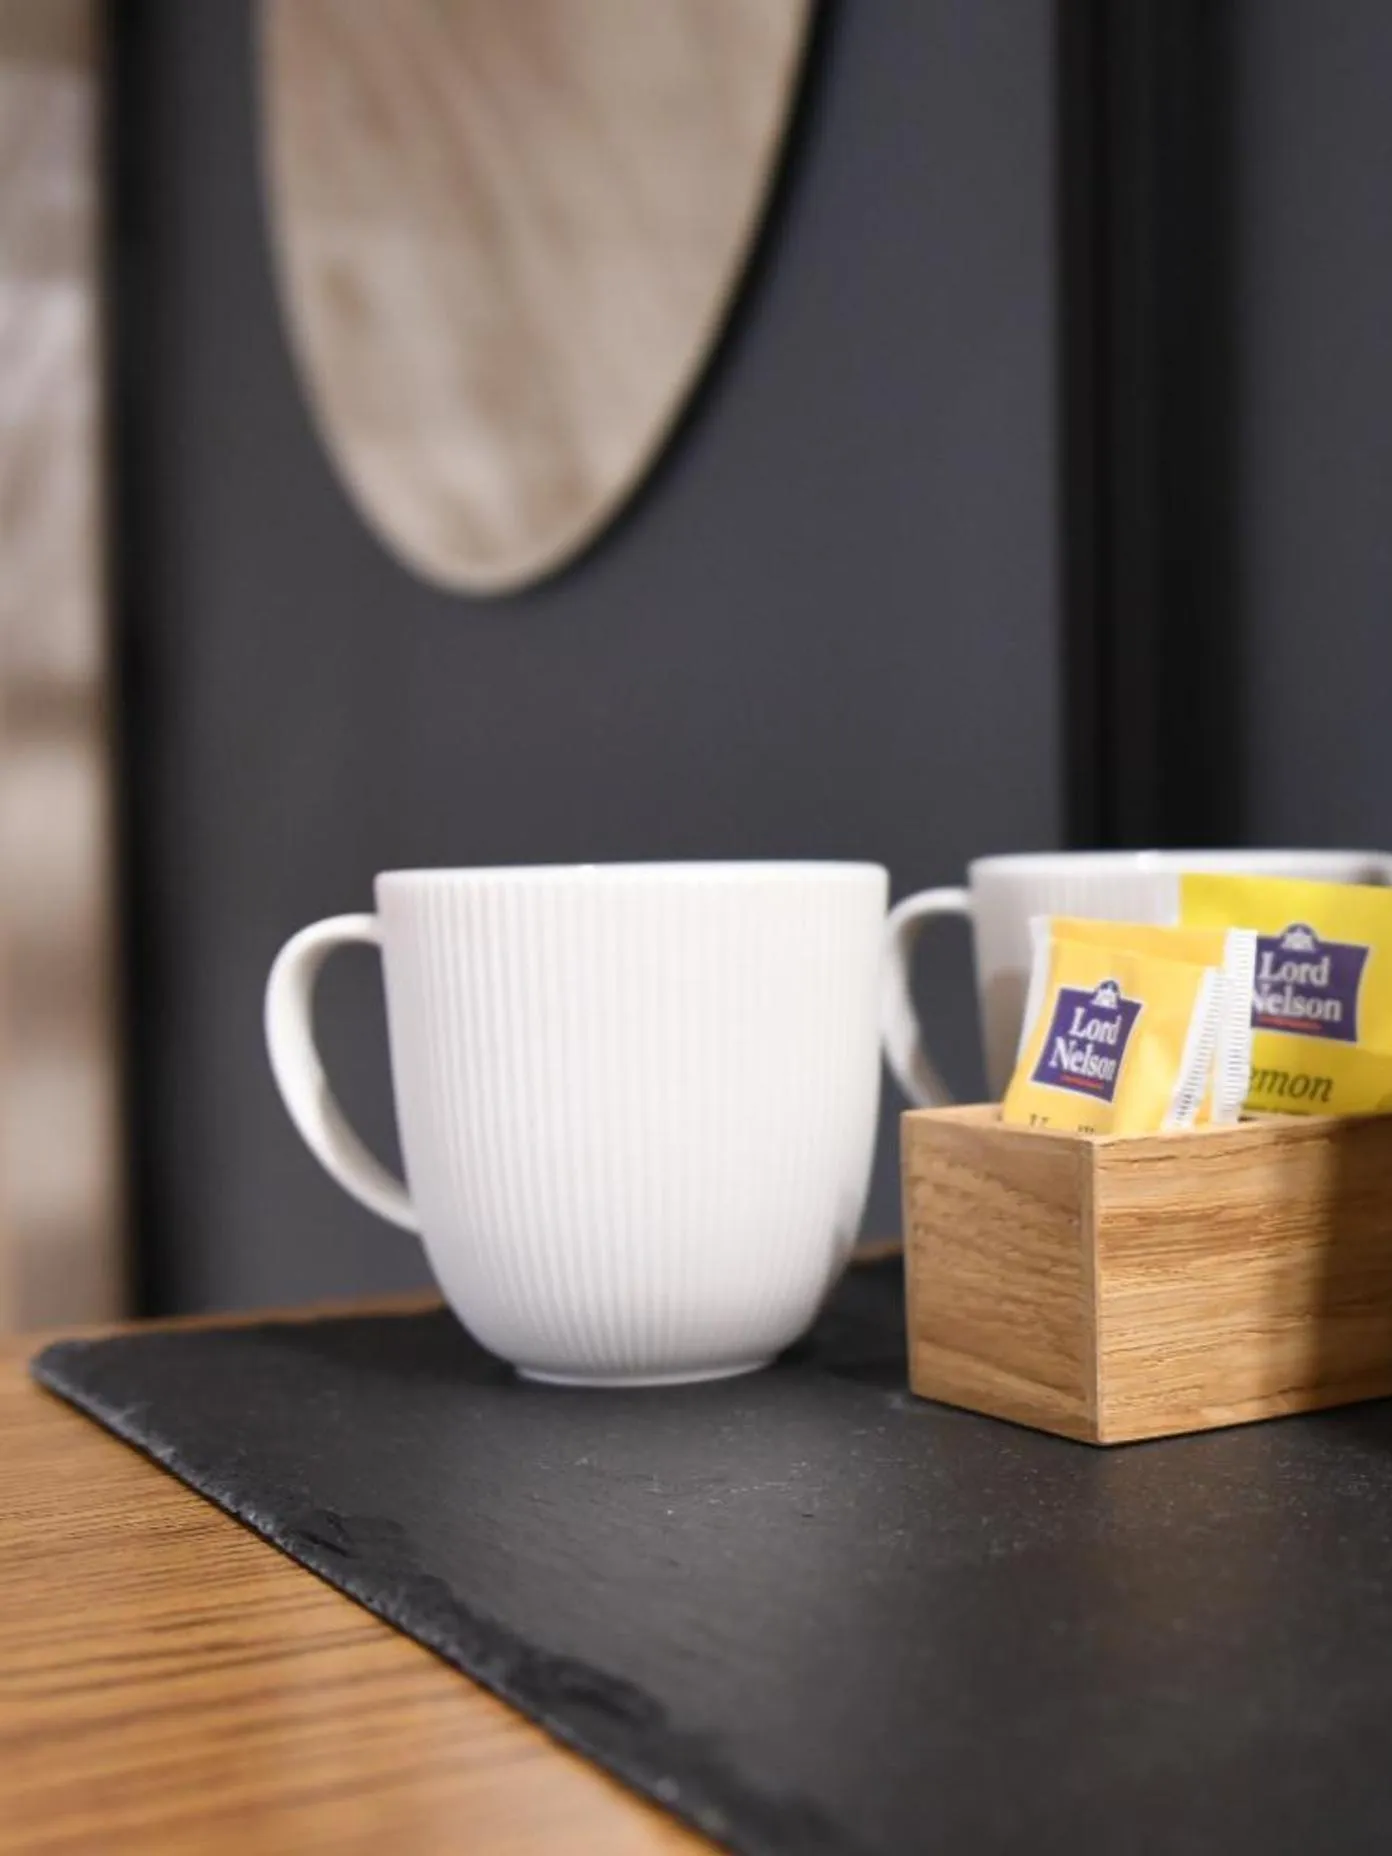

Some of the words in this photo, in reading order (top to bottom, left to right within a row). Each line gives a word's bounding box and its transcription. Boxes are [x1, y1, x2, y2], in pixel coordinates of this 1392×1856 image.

[1258, 951, 1331, 987] Lord
[1069, 1006, 1122, 1046] Lord
[1049, 1036, 1117, 1082] Nelson
[1249, 1066, 1334, 1103] mon
